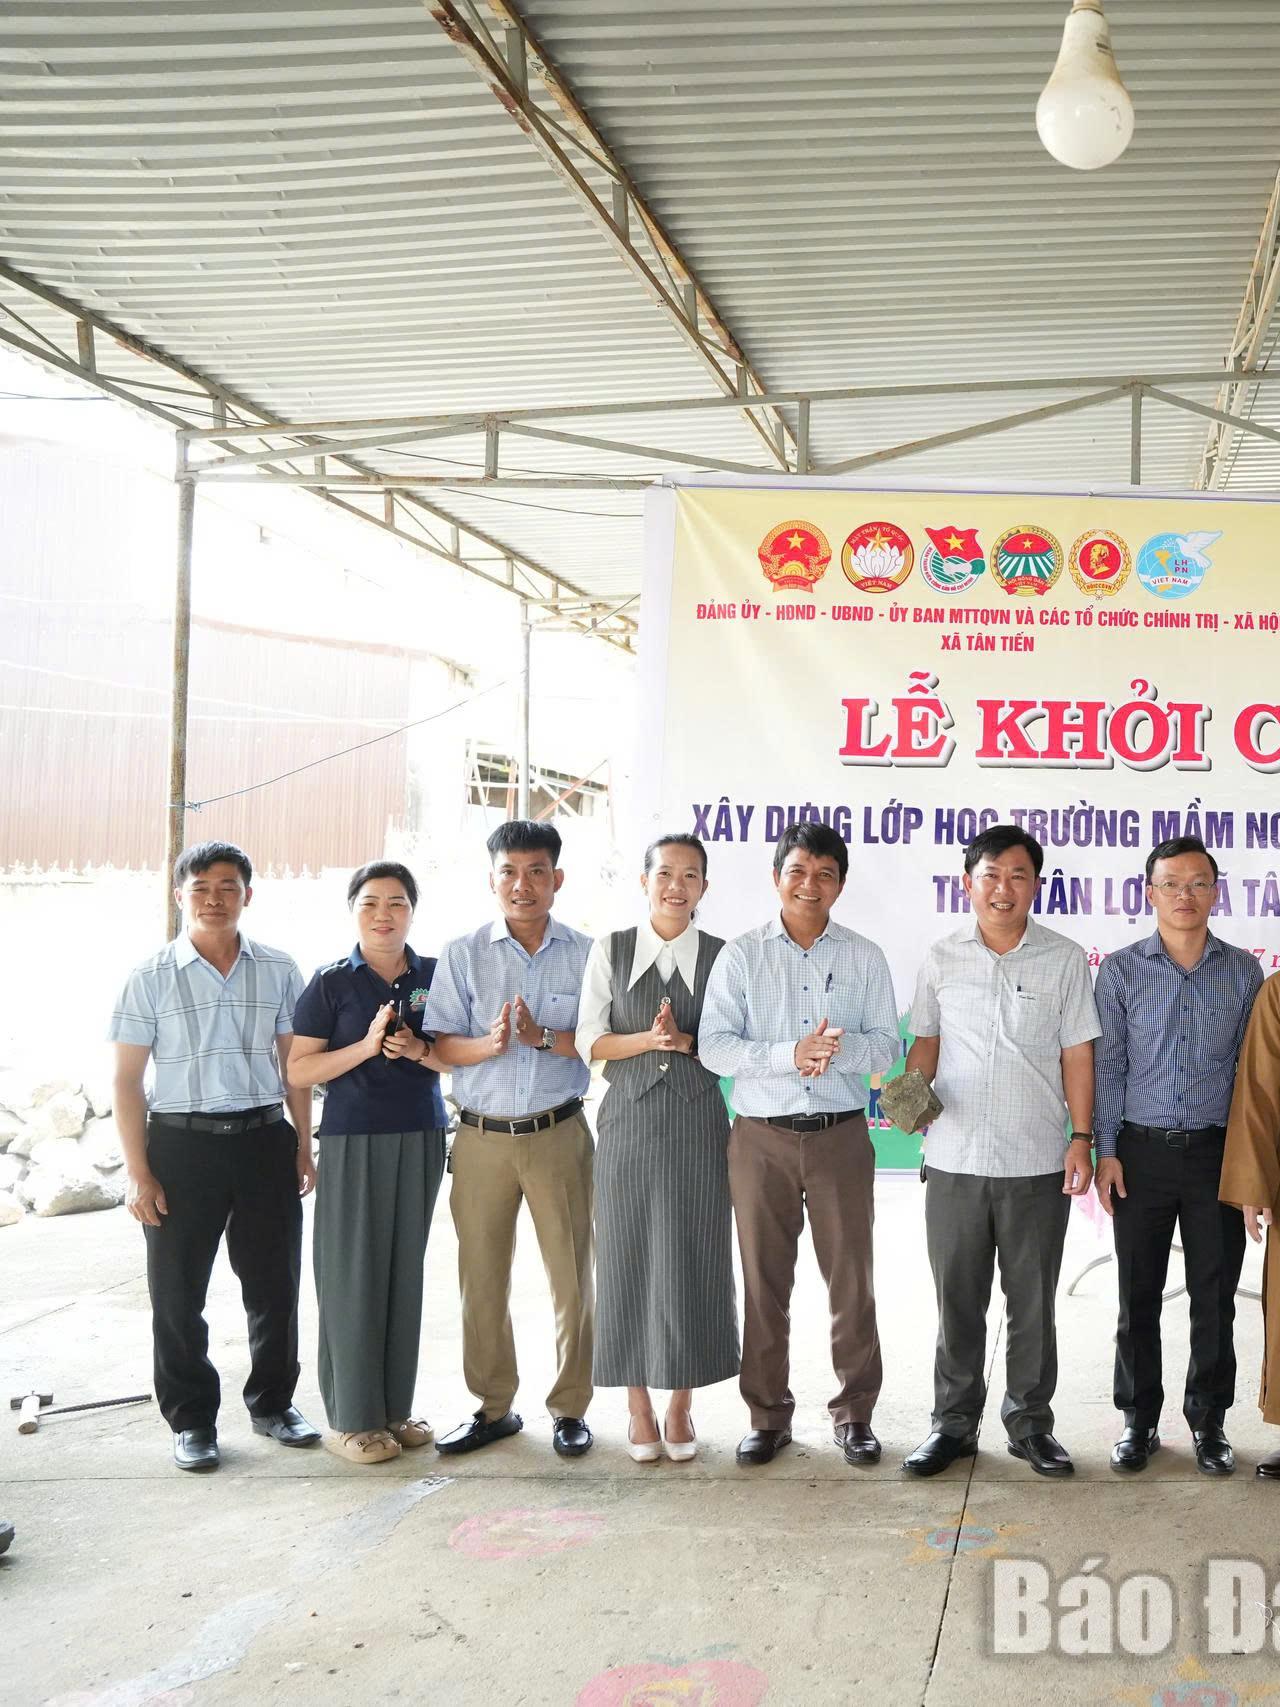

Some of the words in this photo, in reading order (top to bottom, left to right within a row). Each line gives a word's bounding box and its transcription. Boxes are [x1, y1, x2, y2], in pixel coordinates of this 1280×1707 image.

[1171, 577, 1188, 585] NAM
[696, 599, 737, 620] ĐẢNG
[741, 599, 761, 620] ỦY
[776, 604, 816, 621] HĐND
[832, 605, 874, 622] UBND
[889, 601, 909, 623] ỦY
[913, 607, 945, 624] BAN
[949, 608, 1010, 626] MTTQVN
[1015, 607, 1035, 625] VÀ
[1039, 607, 1070, 626] CÁC
[1075, 604, 1095, 627] TỔ
[1097, 608, 1139, 628] CHỨC
[1143, 608, 1191, 628] CHÍNH
[1195, 612, 1218, 633] TRỊ
[1234, 611, 1255, 630] XÃ
[940, 632, 962, 651] XÃ
[966, 632, 996, 651] TÂN
[1000, 631, 1035, 652] TIẾN
[838, 671, 953, 766] LỄ
[975, 678, 1208, 766] KHỞI
[692, 796, 755, 842] XÂY
[863, 798, 924, 845] LỚP
[934, 807, 999, 854] HỌC
[1009, 800, 1140, 848] TRƯỜNG
[1152, 797, 1234, 849] MẦM
